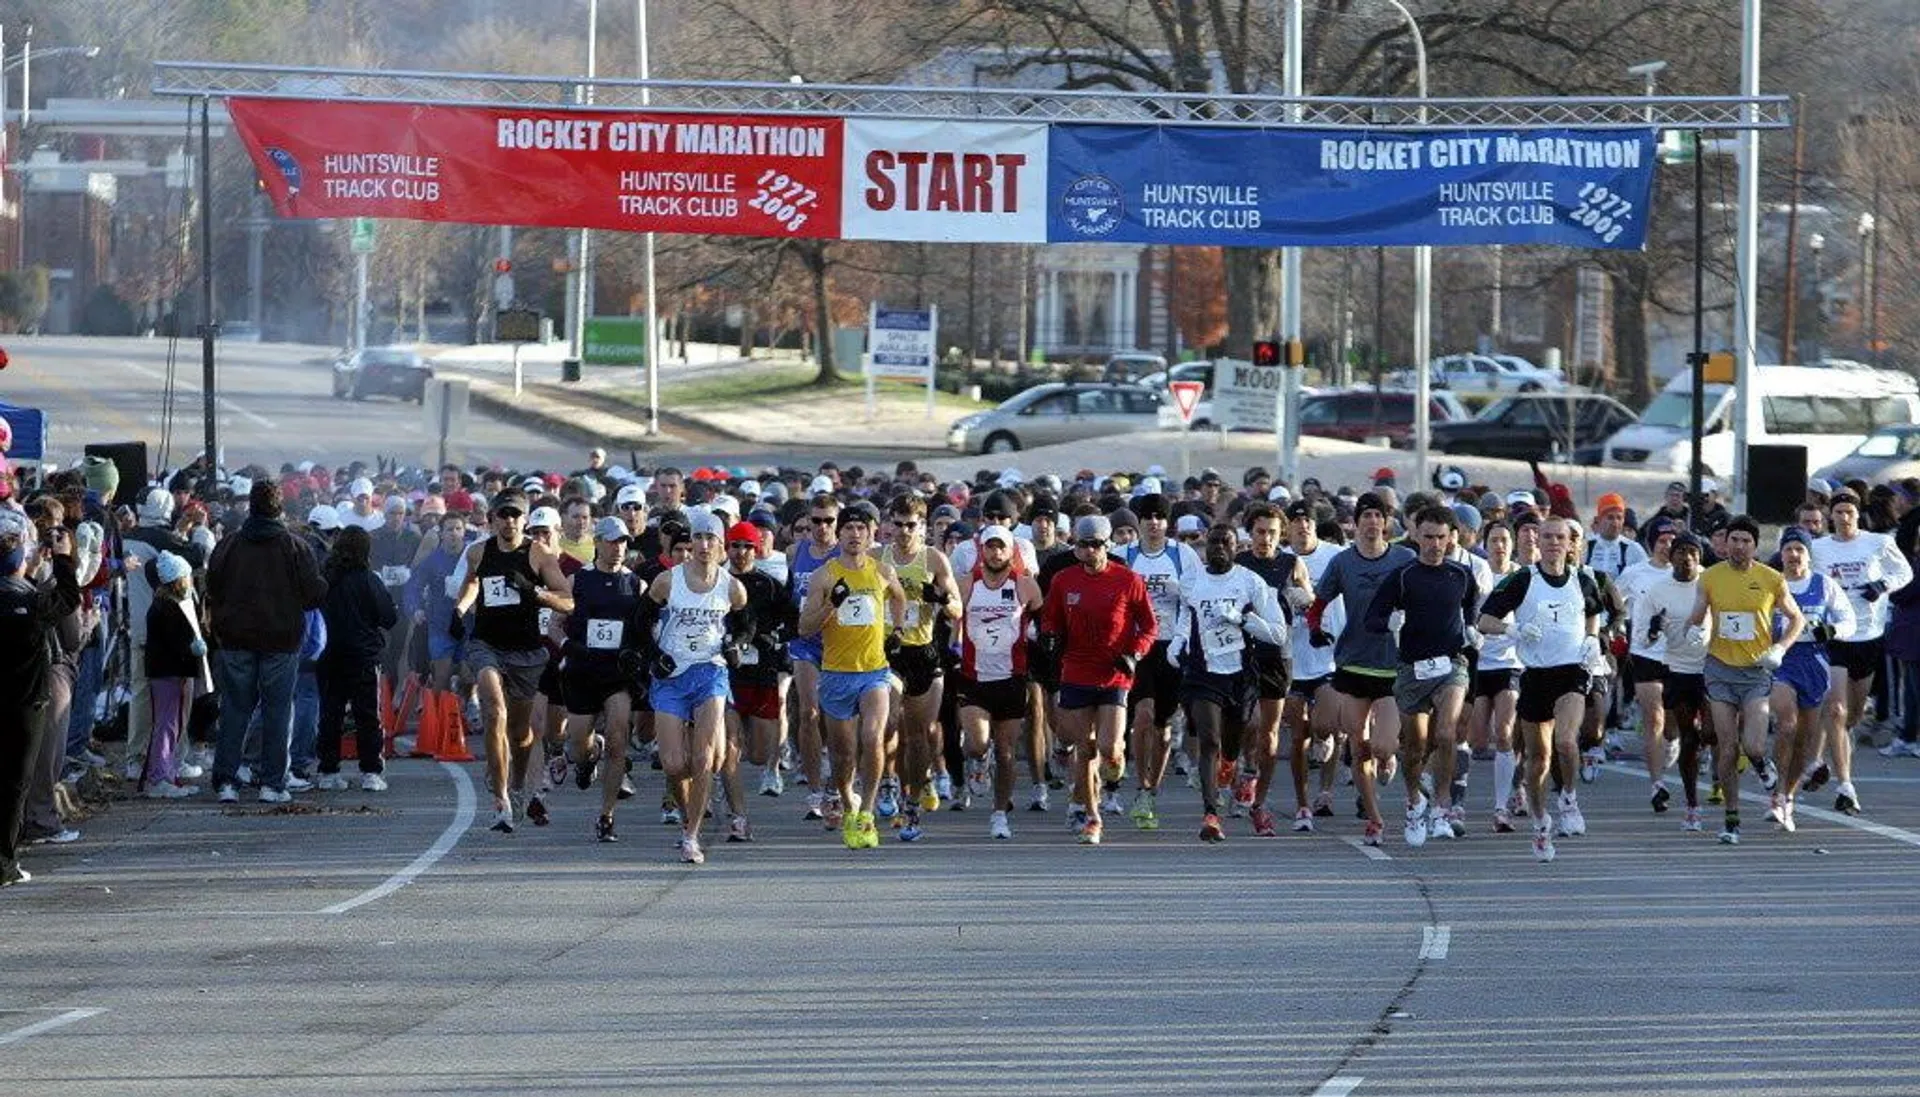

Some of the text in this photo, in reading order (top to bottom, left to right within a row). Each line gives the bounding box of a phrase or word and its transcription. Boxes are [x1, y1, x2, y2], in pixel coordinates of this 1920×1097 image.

[498, 118, 825, 157] ROCKET CITY MARATHON
[1320, 136, 1640, 170] ROCKET CITY MARATHON
[324, 153, 439, 177] HUNTSVILLE
[324, 179, 440, 201] TRACK CLUB
[620, 170, 736, 192] HUNTSVILLE
[865, 150, 1026, 213] START
[1143, 184, 1258, 205] HUNTSVILLE
[1439, 182, 1554, 202] HUNTSVILLE
[618, 195, 739, 217] TRACK CLUB
[748, 189, 808, 232] 2008
[1438, 206, 1554, 226] TRACK CLUB
[1141, 208, 1261, 228] TRACK CLUB
[1569, 202, 1623, 243] 2008
[853, 605, 860, 617] 2
[597, 628, 613, 640] 63
[1732, 621, 1740, 633] 3
[690, 641, 698, 651] 6
[991, 635, 999, 646] 7
[1218, 634, 1234, 647] 16
